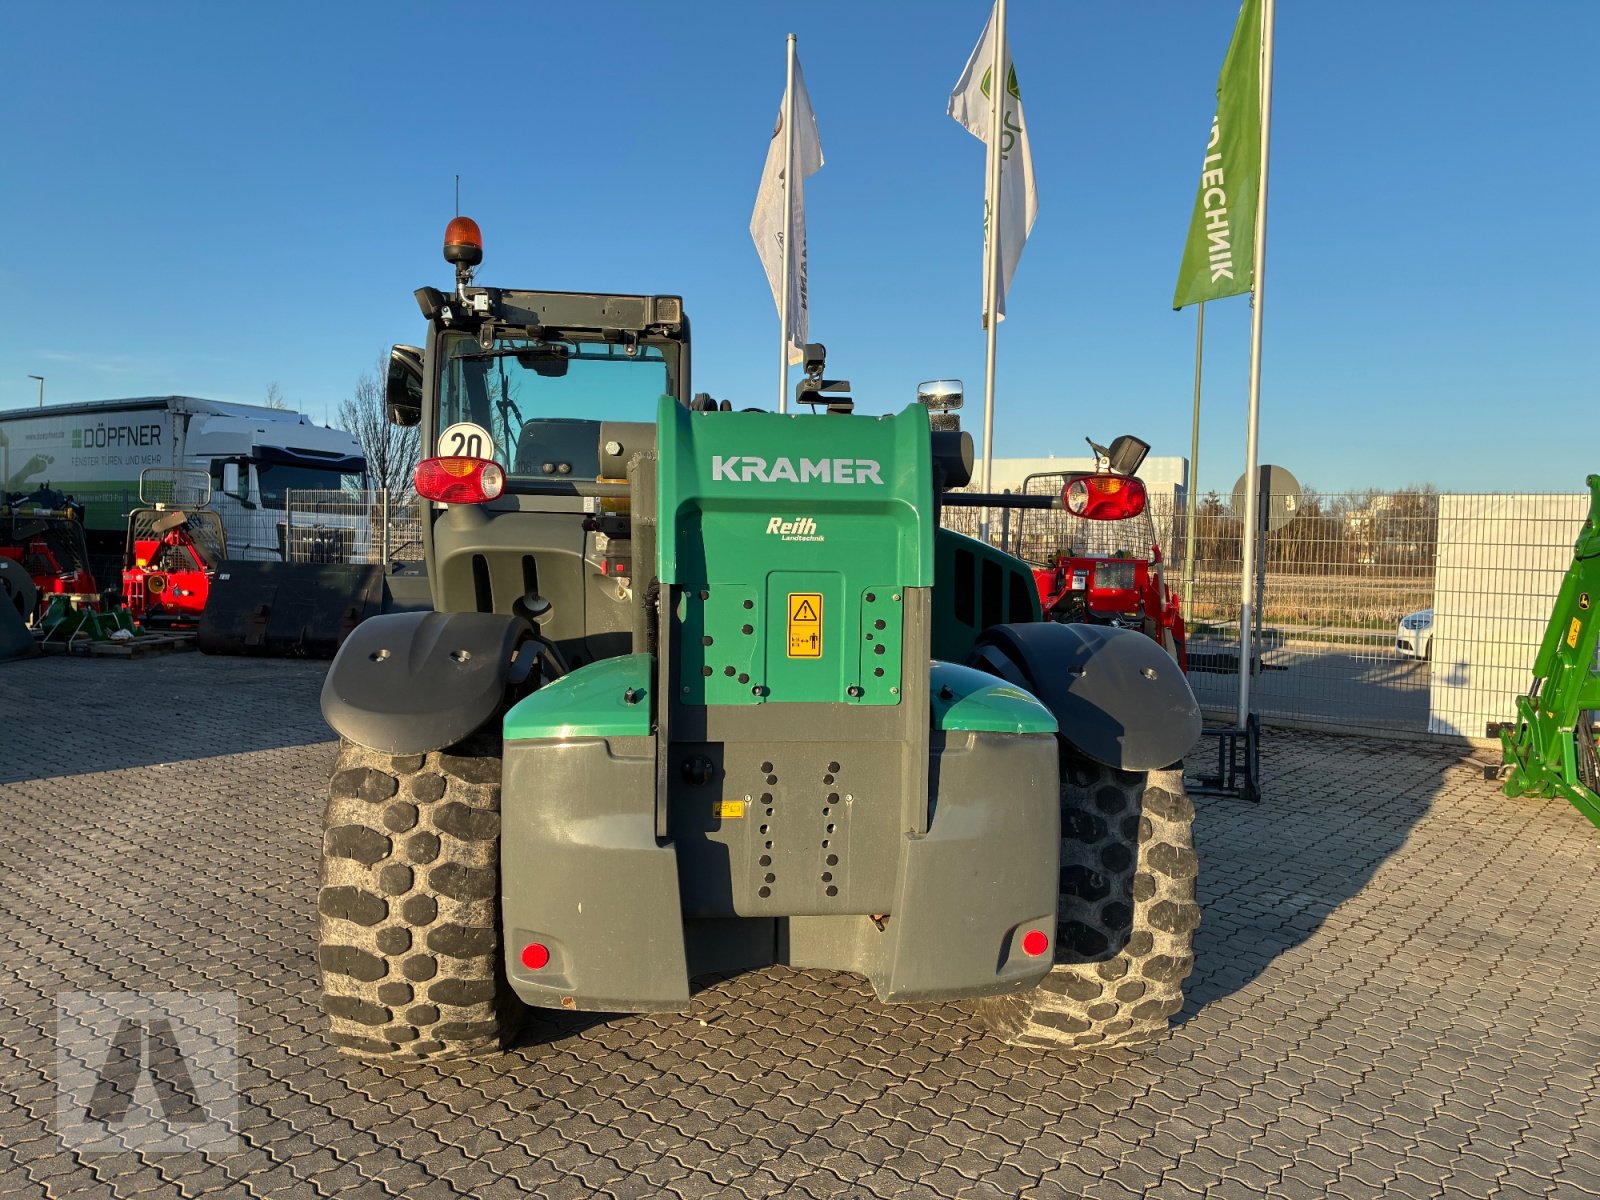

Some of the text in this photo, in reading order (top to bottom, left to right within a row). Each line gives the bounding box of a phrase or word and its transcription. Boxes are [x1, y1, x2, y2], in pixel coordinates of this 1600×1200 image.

[84, 422, 161, 448] DÖPFNER
[451, 432, 482, 458] 20
[71, 456, 99, 467] FENSTER
[125, 455, 140, 465] UND
[141, 454, 162, 465] MEHR
[712, 455, 885, 485] KRAMER
[766, 517, 817, 535] Reith
[781, 534, 825, 542] Landtechnik
